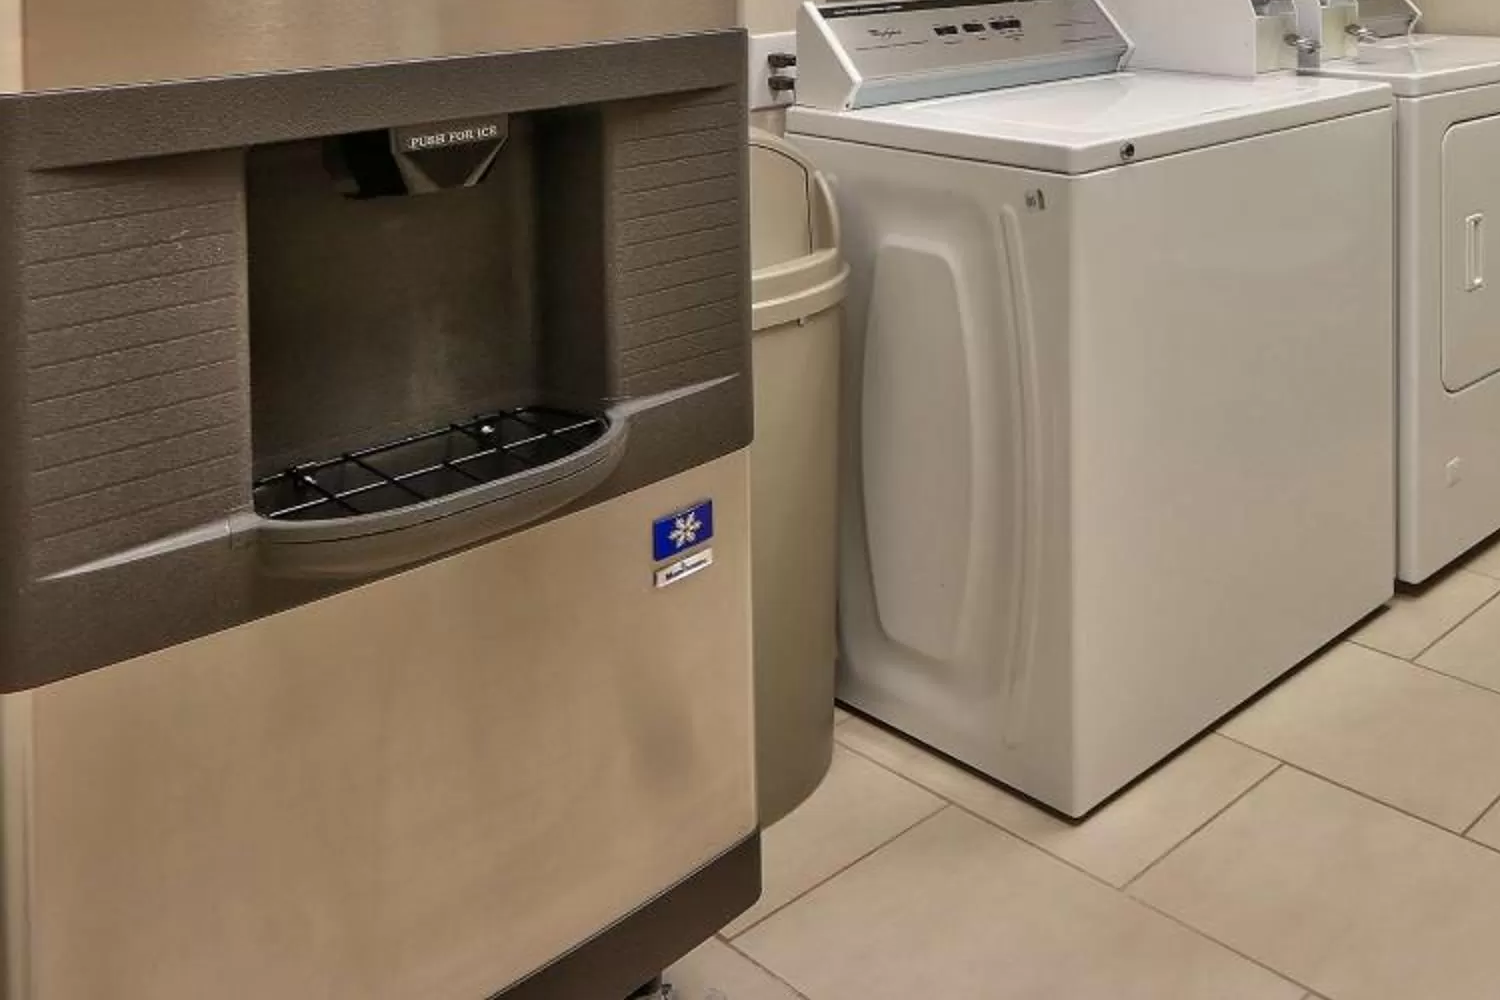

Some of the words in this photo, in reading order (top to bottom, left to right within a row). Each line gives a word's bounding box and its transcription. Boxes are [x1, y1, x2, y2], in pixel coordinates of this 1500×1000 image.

[411, 132, 445, 148] PUSH
[449, 129, 473, 143] FOR
[478, 124, 497, 137] ICE
